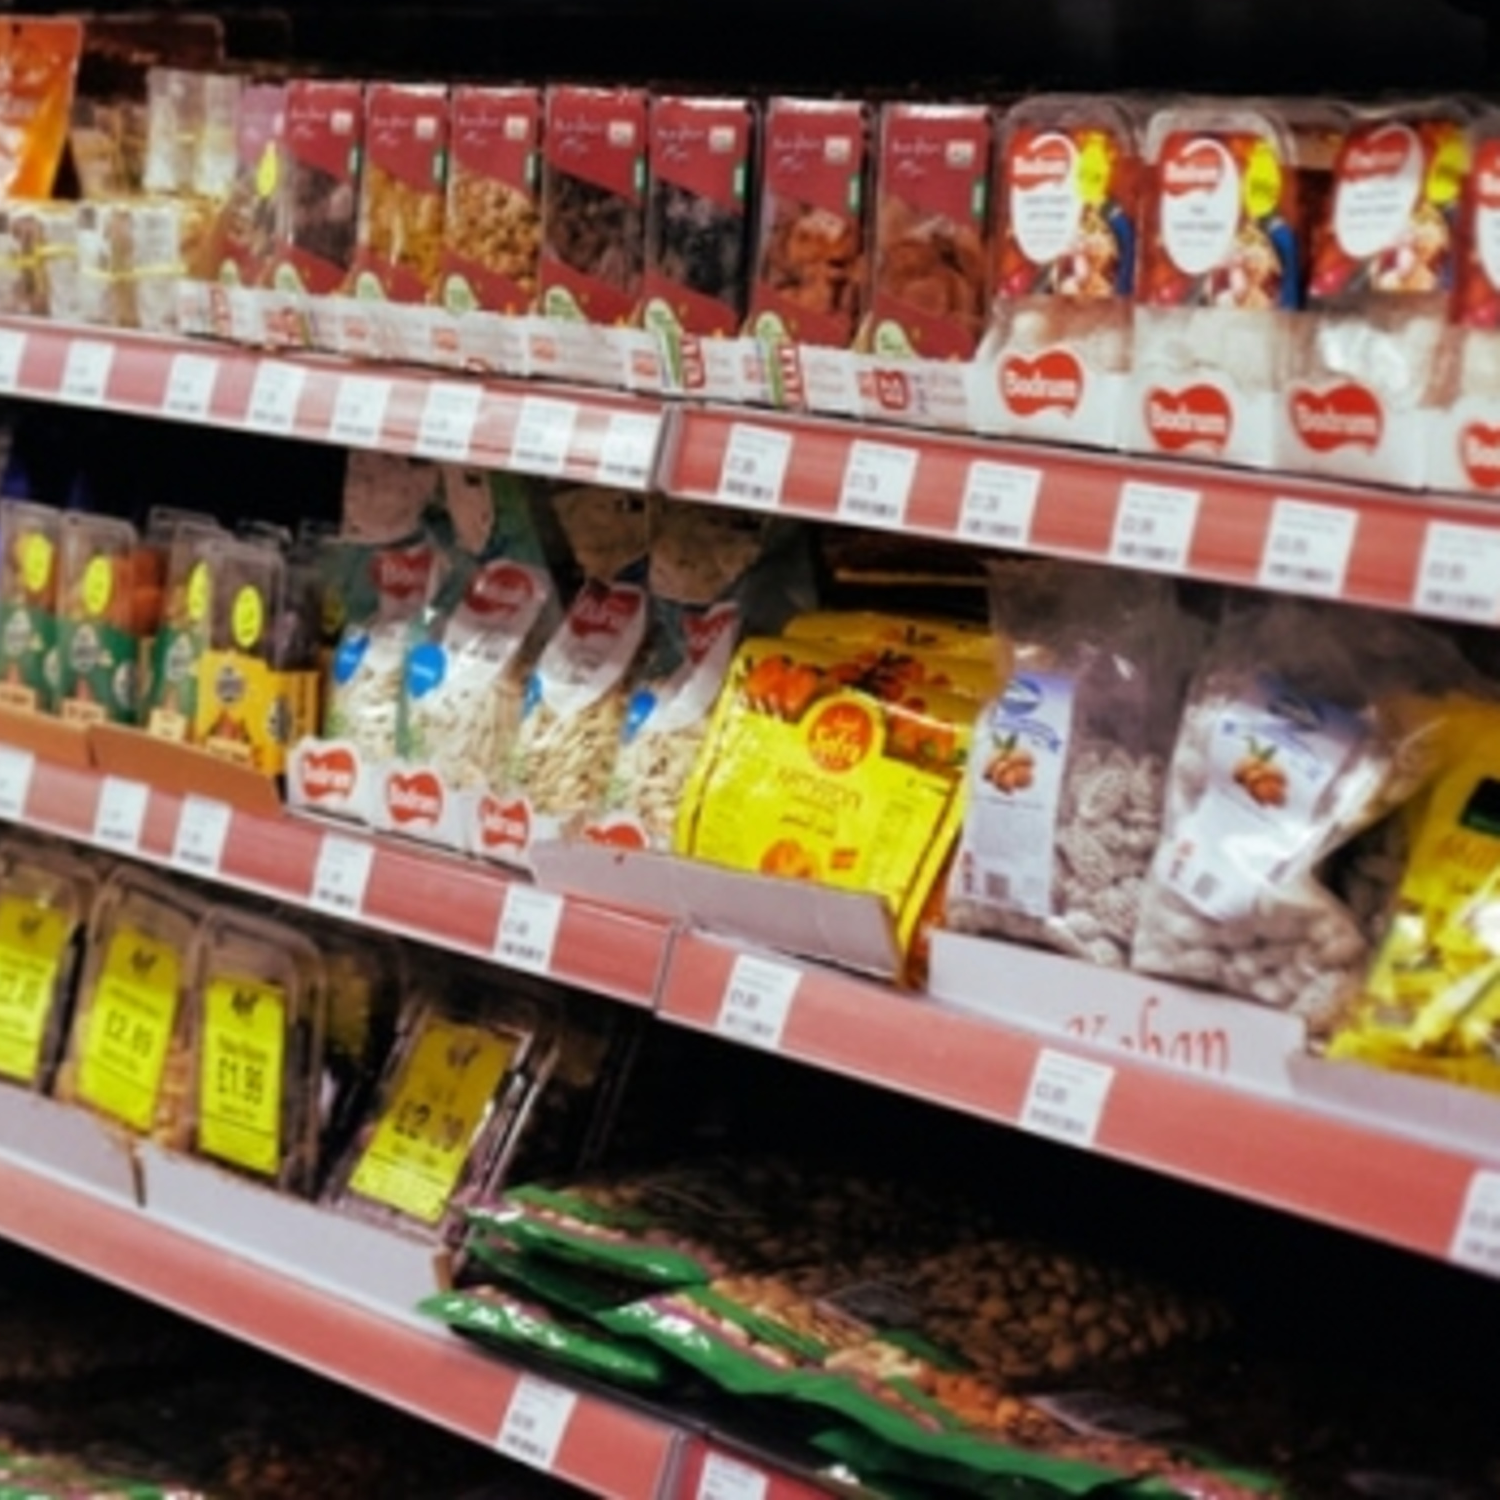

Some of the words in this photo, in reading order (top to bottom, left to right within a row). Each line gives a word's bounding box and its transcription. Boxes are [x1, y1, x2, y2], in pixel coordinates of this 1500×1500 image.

[1004, 368, 1078, 400] Bodrum
[1149, 402, 1227, 436] Bodrum
[1299, 404, 1379, 438] Bodrum
